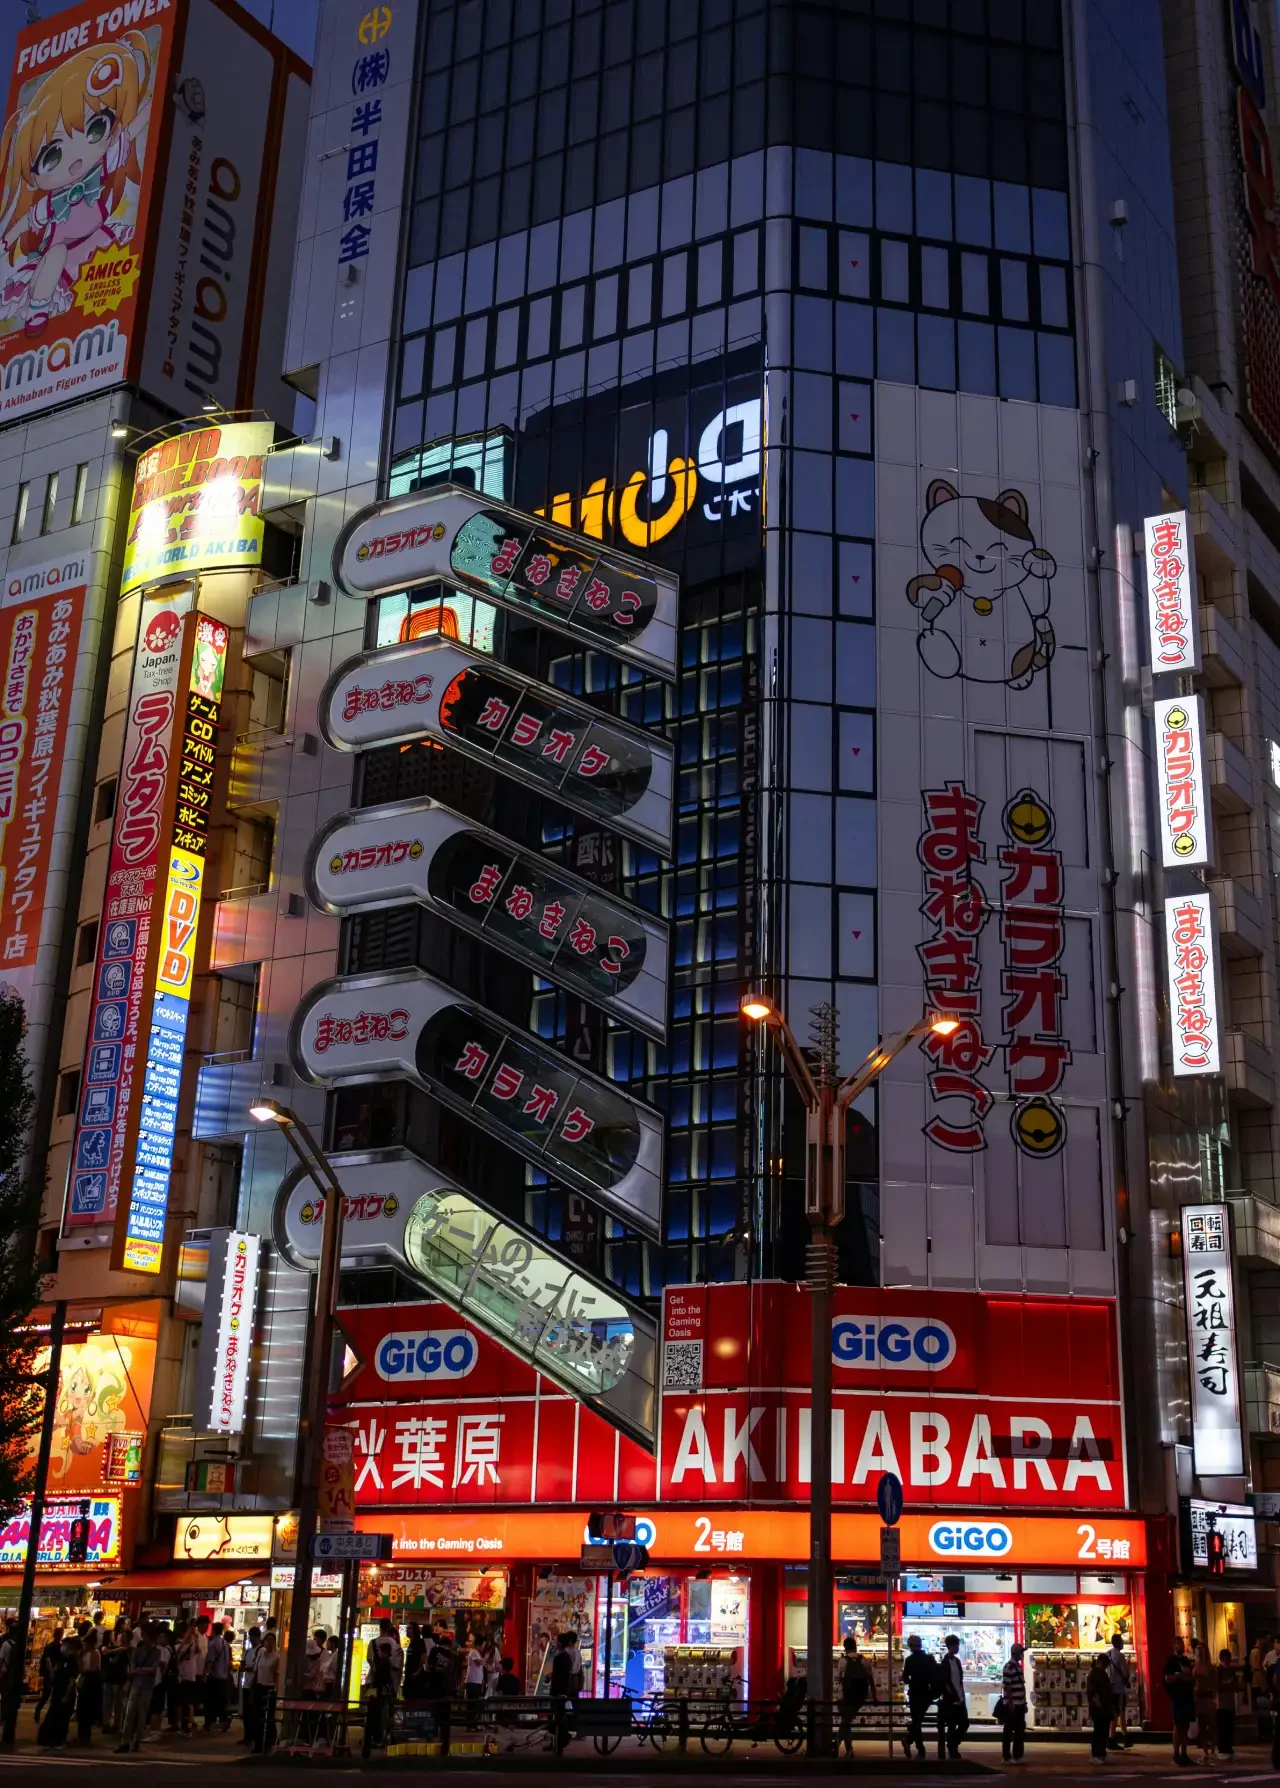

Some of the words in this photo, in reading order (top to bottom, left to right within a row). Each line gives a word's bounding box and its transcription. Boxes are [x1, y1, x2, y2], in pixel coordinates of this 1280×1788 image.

[17, 19, 92, 73] FIGURE
[96, 0, 171, 40] TOWER
[86, 258, 133, 282] AMICO
[89, 279, 121, 291] ENDLESS
[84, 286, 122, 300] SHOPPING
[0, 322, 117, 392] miami
[5, 386, 53, 410] Akihabara
[56, 371, 87, 391] Figure
[90, 361, 120, 378] Tower
[367, 523, 436, 559] カラオケ
[9, 559, 85, 597] amiami
[489, 538, 643, 626] まねきねこ
[1151, 518, 1188, 664] まねきねこ
[7, 616, 33, 713] おかげさまで
[144, 666, 173, 679] Tax-free
[153, 676, 172, 687] Shop
[190, 696, 217, 721] ゲーム
[342, 673, 435, 723] まねきねこ
[190, 720, 213, 741] CD
[477, 696, 611, 778] カラオケ
[185, 739, 213, 764] アイドル
[4, 598, 73, 960] あみあみ秋葉原フィギュアタワー店
[118, 691, 174, 864] ラムタラ
[181, 760, 213, 785] アニメ
[1163, 729, 1197, 837] カラオケ
[179, 784, 208, 807] コミック
[178, 806, 205, 826] ホビー
[342, 840, 411, 872] カラオケ
[121, 882, 144, 897] アキバ
[469, 864, 630, 974] まねきねこ
[160, 888, 198, 988] DVD
[916, 780, 997, 1153] まねきねこ
[998, 844, 1073, 1100] カラオケ
[1172, 902, 1213, 1068] まねきねこ
[313, 1008, 411, 1053] まねきねこ
[454, 1040, 596, 1143] カラオケ
[135, 1166, 144, 1174] 1F
[130, 1202, 139, 1210] B1
[423, 1204, 533, 1274] ゲームの
[1189, 1216, 1223, 1232] 回転
[1189, 1234, 1223, 1250] 寿司
[231, 1253, 247, 1317] カラオケ
[669, 1295, 684, 1305] Get
[669, 1316, 701, 1328] Gaming
[671, 1305, 688, 1315] into
[689, 1305, 701, 1315] the
[669, 1327, 692, 1338] Oasis
[832, 1321, 951, 1366] GiGO
[1193, 1269, 1229, 1396] 元祖寿司
[378, 1334, 474, 1376] GiGO
[220, 1334, 241, 1427] まねきねこ
[400, 1538, 418, 1550] into
[419, 1538, 436, 1550] the
[437, 1537, 474, 1552] Gaming
[476, 1538, 503, 1550] Oasis
[694, 1517, 744, 1552] 2号館
[933, 1526, 1007, 1552] GiGO
[1077, 1524, 1130, 1559] 2号館
[396, 1569, 432, 1581] フレスカ
[388, 1584, 406, 1604] B1
